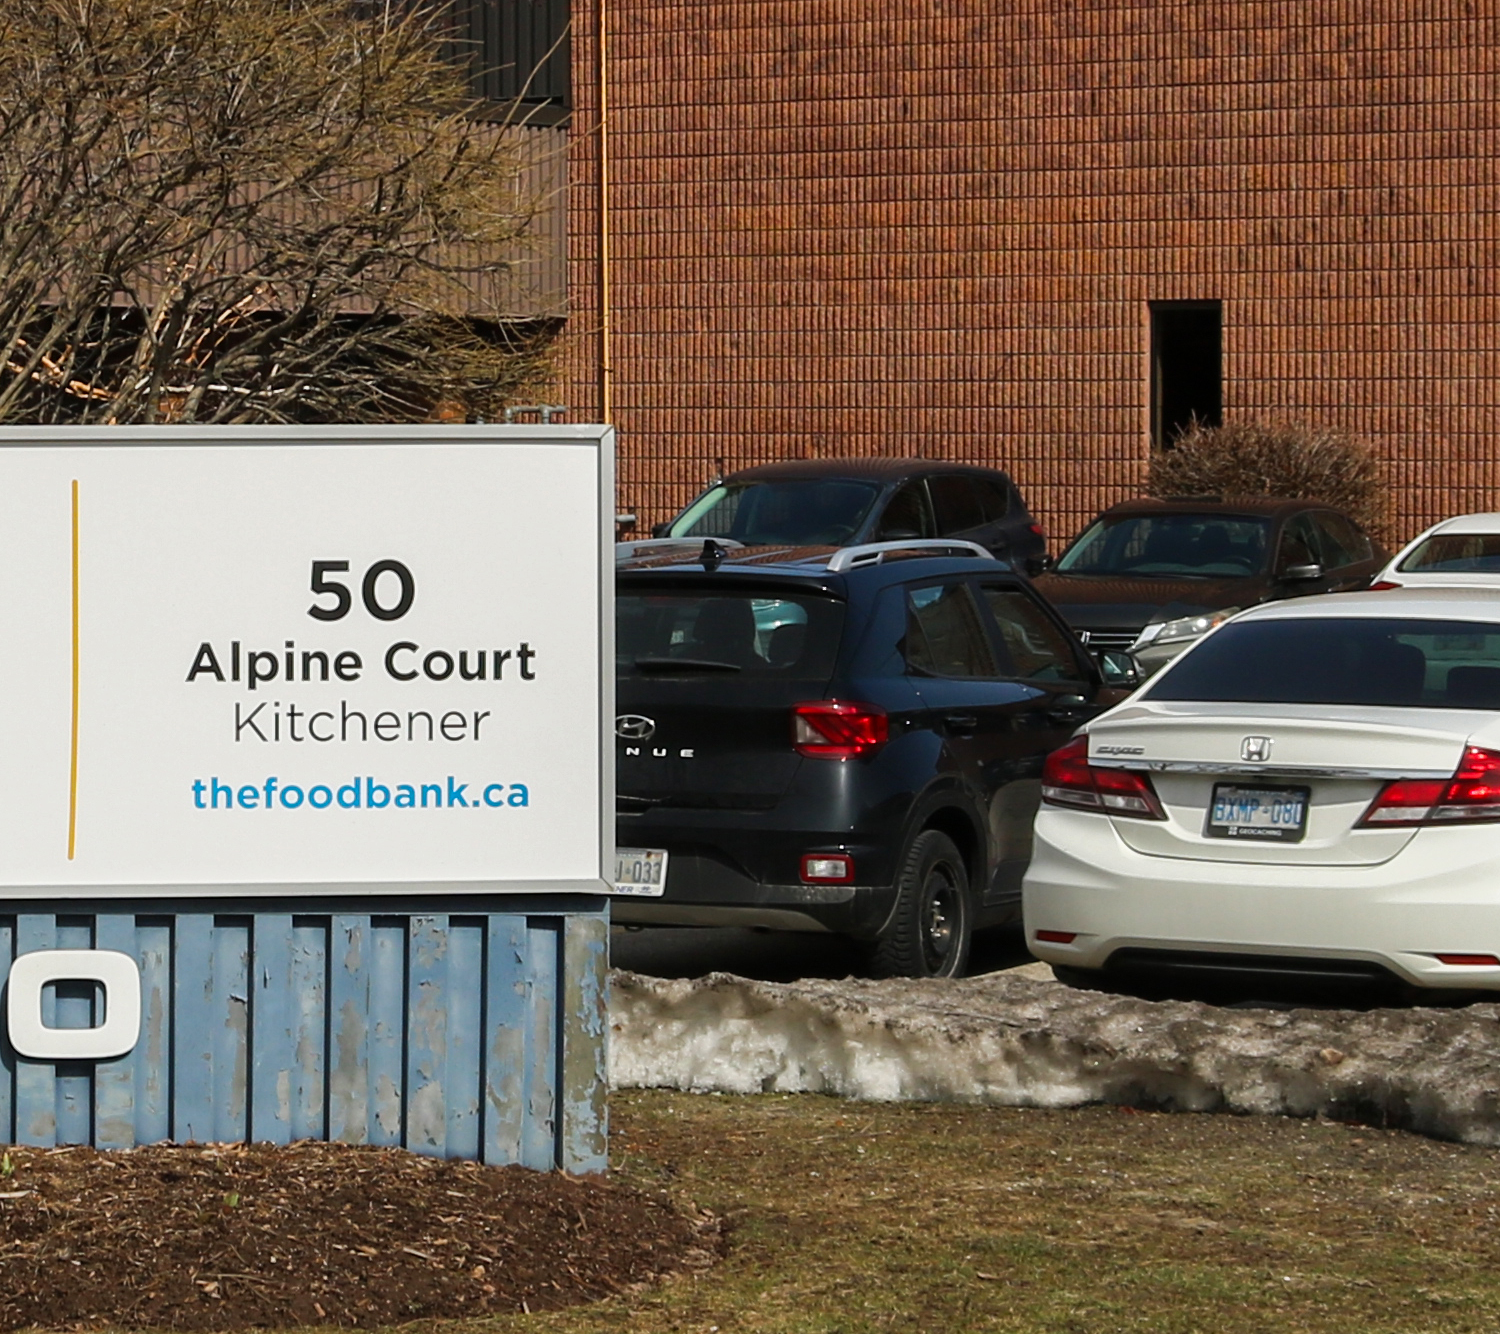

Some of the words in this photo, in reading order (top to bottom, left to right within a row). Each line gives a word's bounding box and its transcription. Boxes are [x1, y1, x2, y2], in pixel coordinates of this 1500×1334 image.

[307, 559, 415, 621] 50
[186, 641, 362, 684] Alpine
[385, 642, 535, 682] Court
[236, 701, 490, 742] Kitchener
[626, 747, 694, 758] NUE
[192, 776, 528, 810] thefoodbank.ca
[1239, 827, 1282, 836] GEOCACHING
